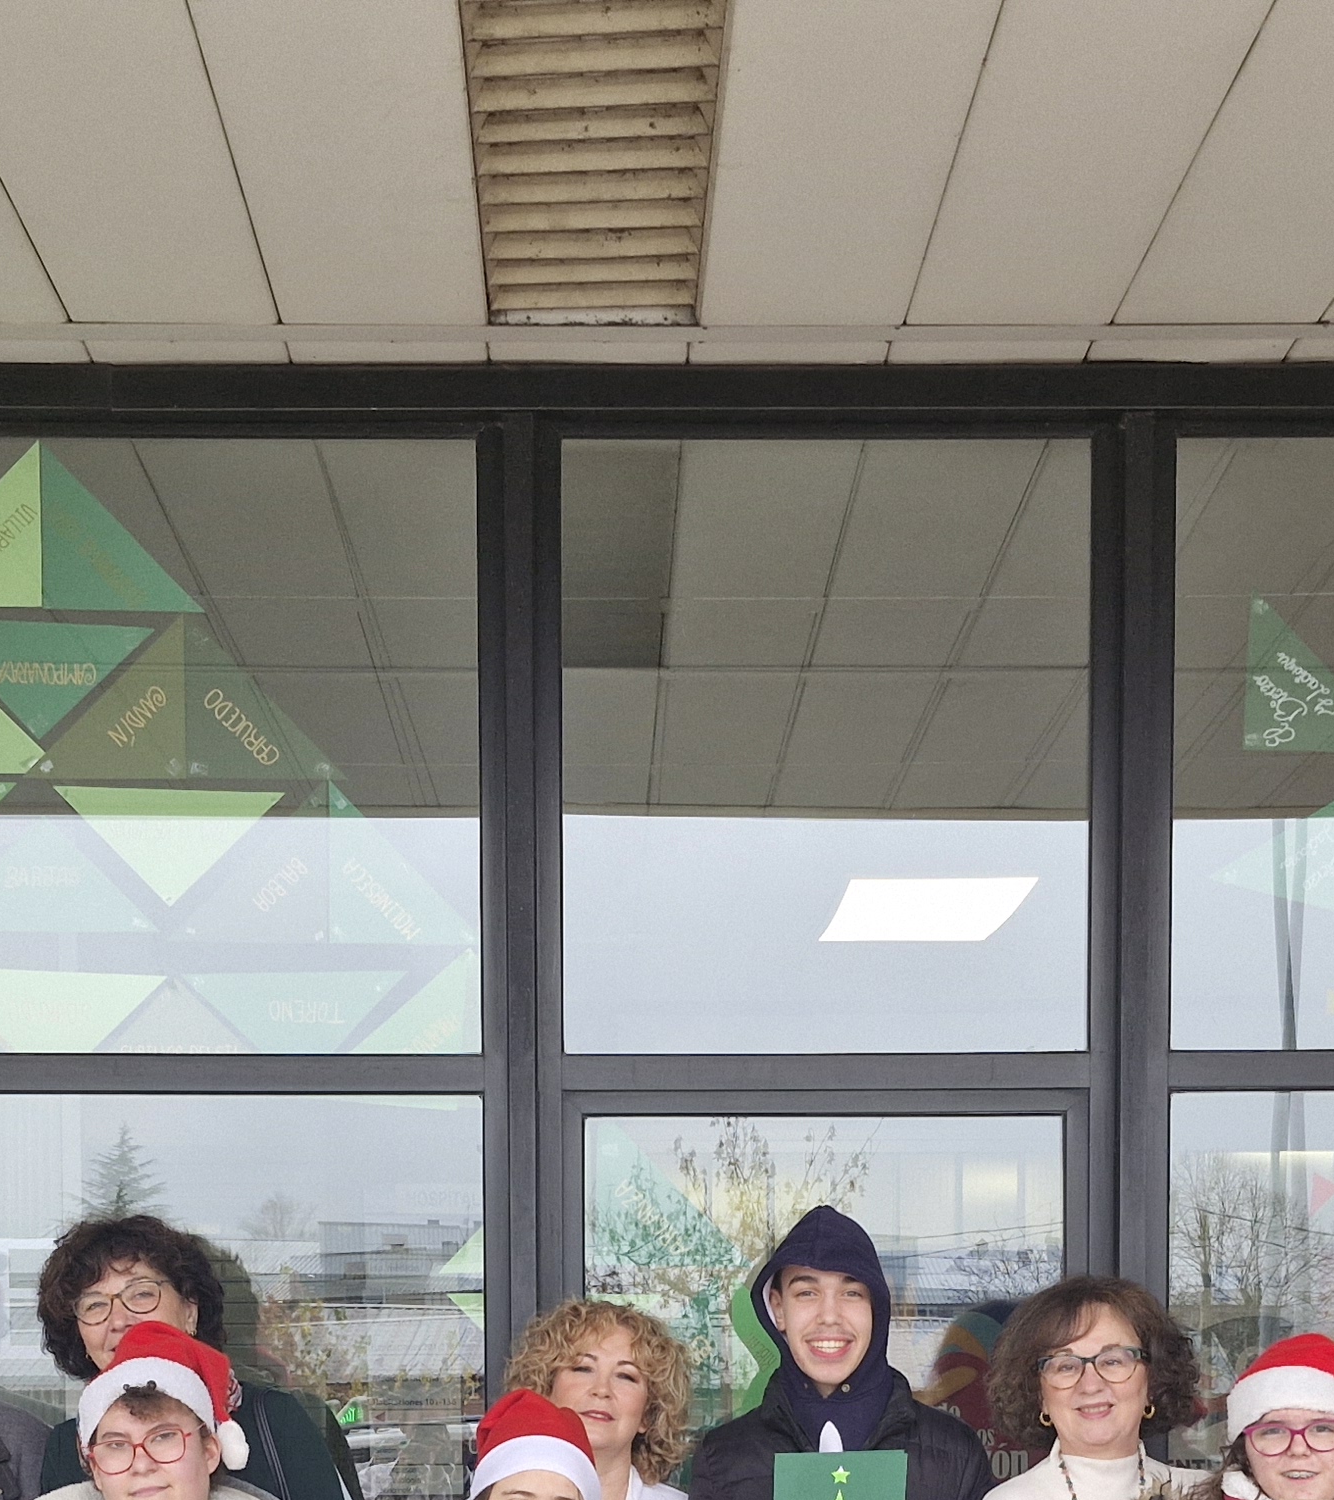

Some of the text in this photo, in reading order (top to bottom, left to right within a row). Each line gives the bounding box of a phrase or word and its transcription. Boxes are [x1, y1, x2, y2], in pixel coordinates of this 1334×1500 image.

[106, 685, 167, 749] CANDÍN
[1253, 675, 1308, 722] Bierzo
[203, 688, 280, 766] CARUCEDO
[1263, 719, 1295, 747] El
[341, 856, 421, 941] MOLINASECA
[268, 999, 345, 1025] TORENO
